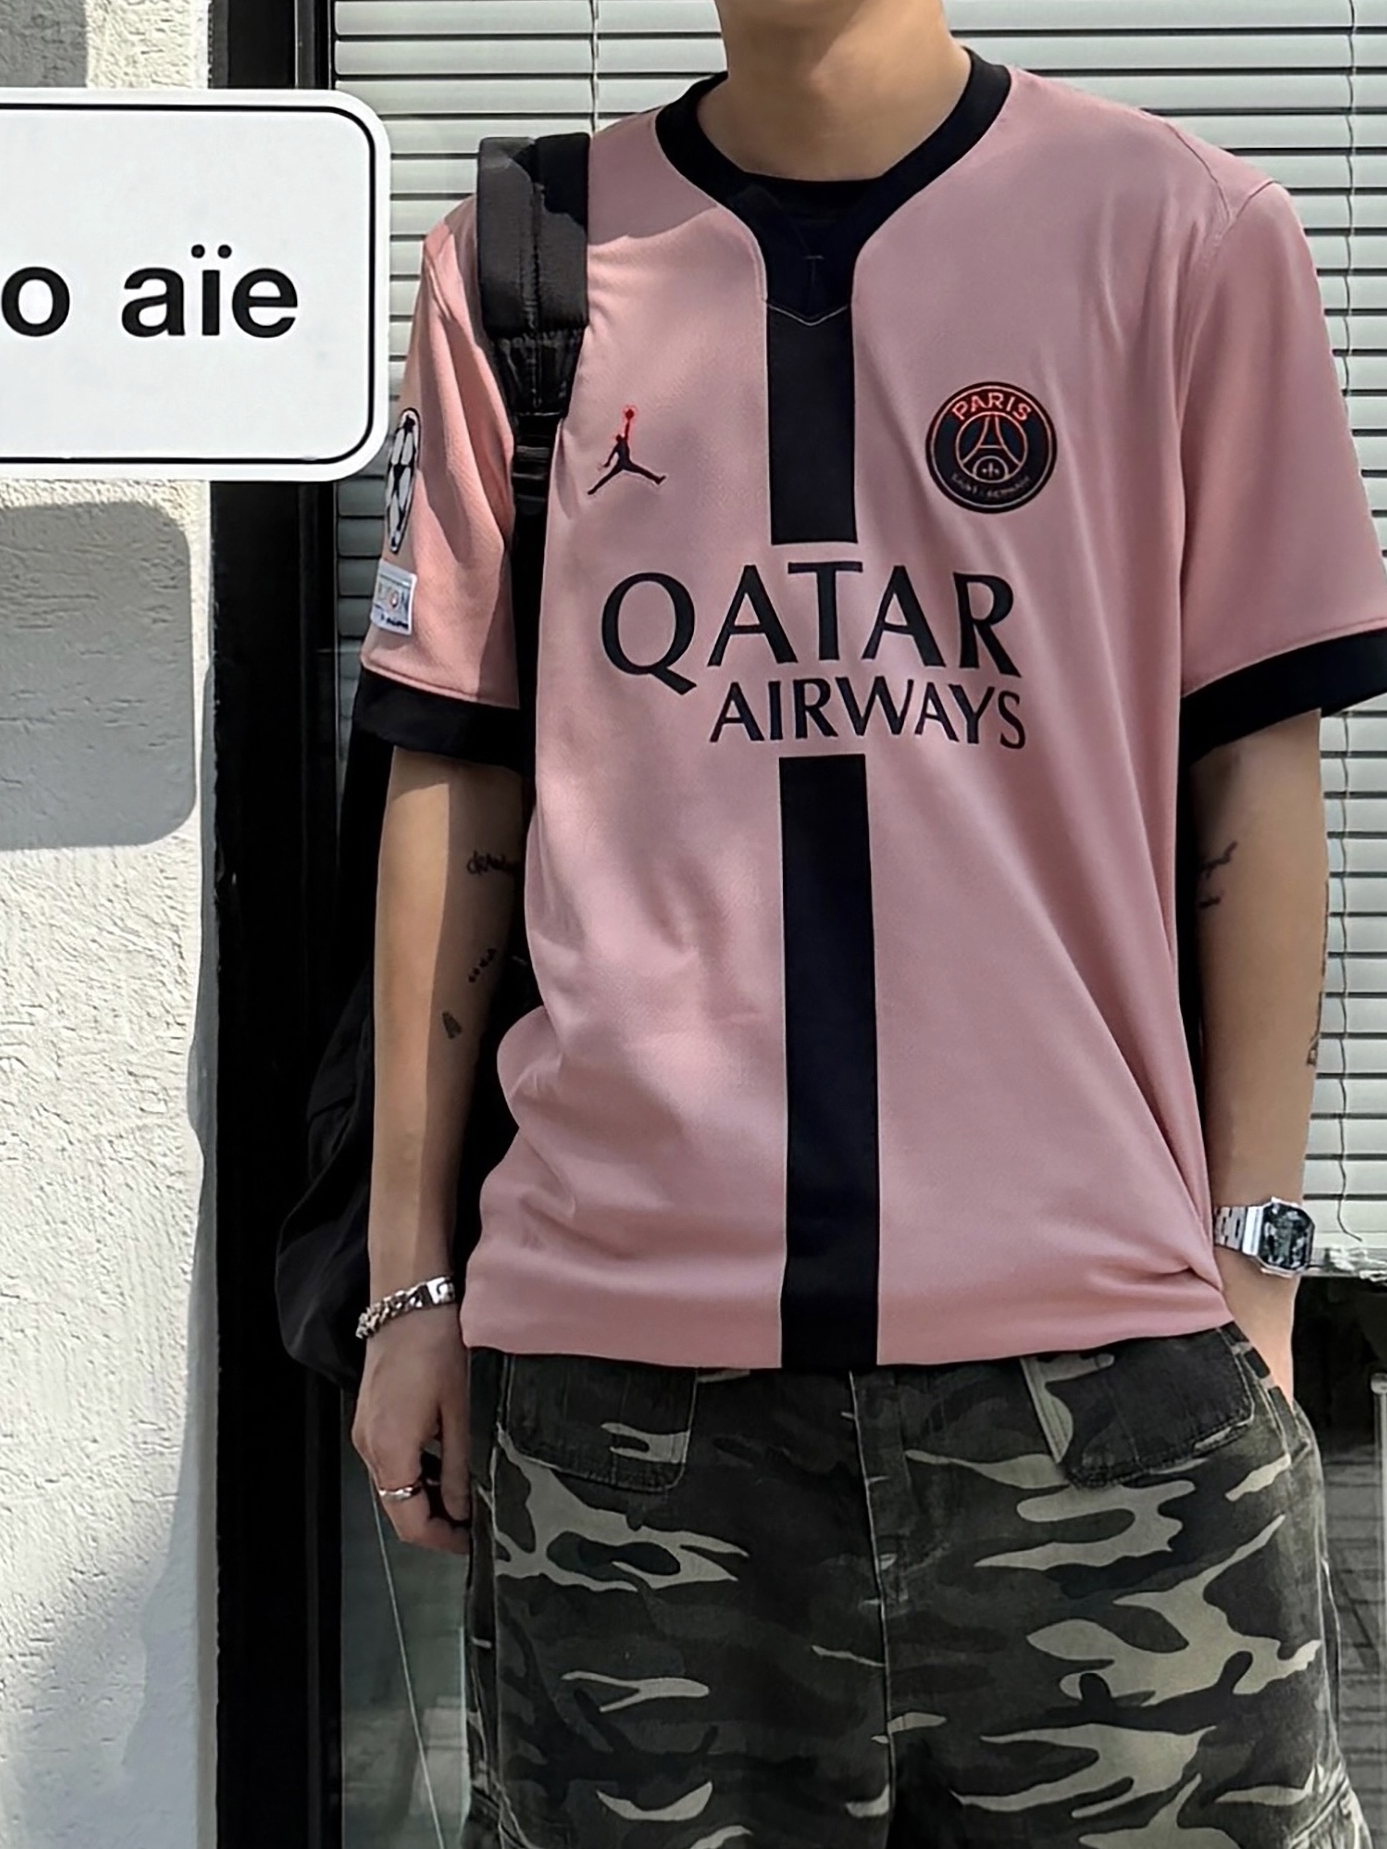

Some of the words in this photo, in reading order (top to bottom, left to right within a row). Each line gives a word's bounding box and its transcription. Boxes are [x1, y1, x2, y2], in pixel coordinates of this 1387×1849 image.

[121, 244, 298, 339] aïe
[951, 391, 1033, 421] PARIS
[601, 560, 1022, 696] QATAR
[709, 675, 1026, 750] AIRWAYS
